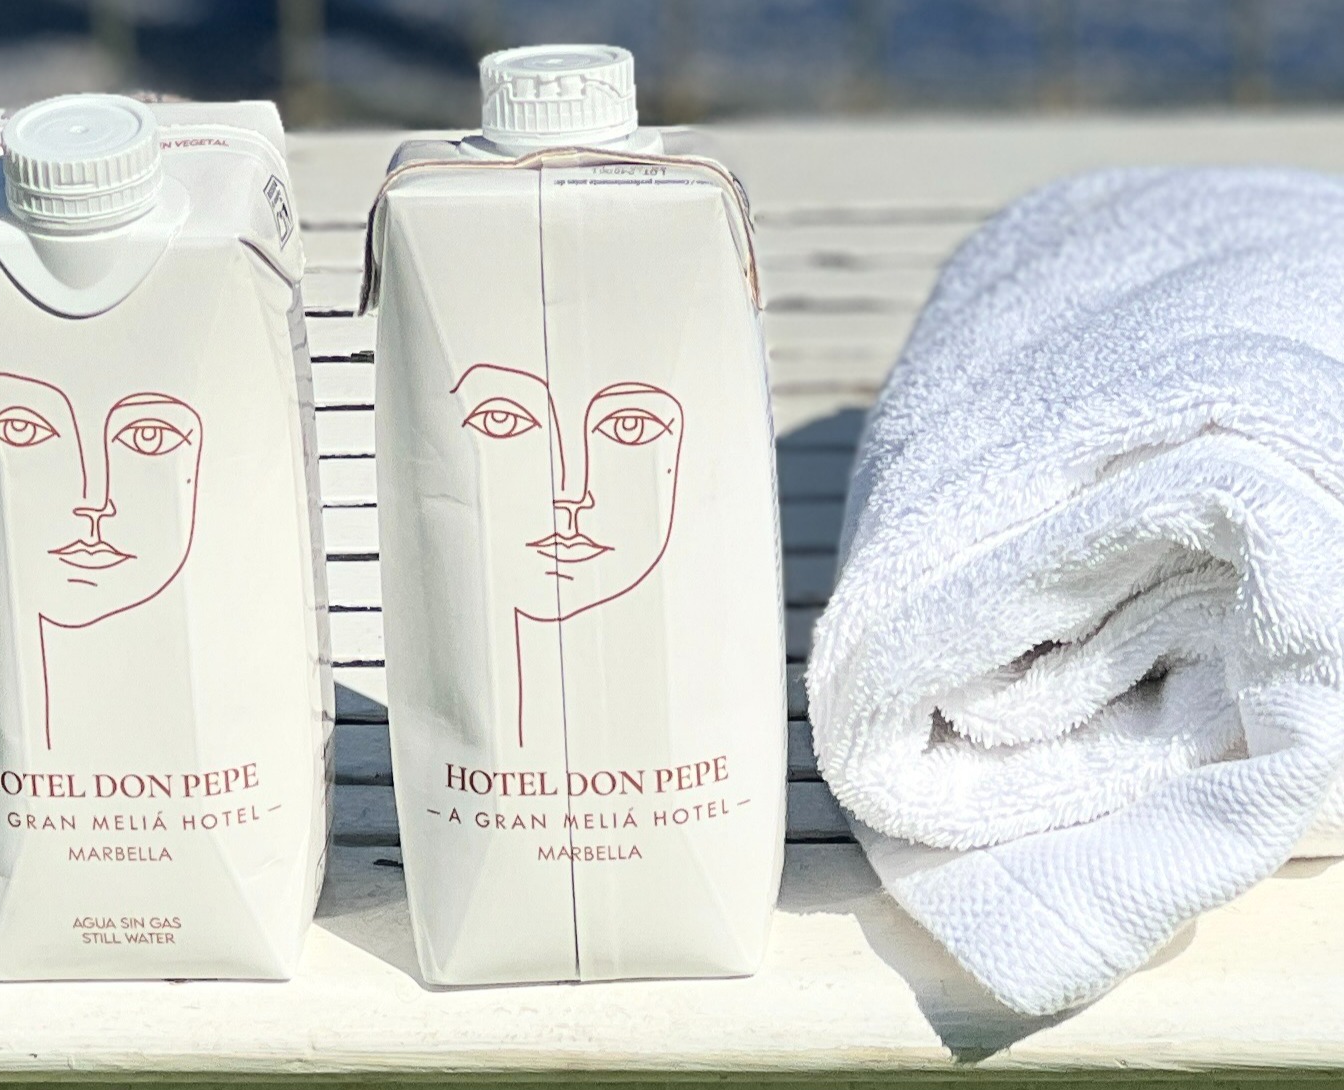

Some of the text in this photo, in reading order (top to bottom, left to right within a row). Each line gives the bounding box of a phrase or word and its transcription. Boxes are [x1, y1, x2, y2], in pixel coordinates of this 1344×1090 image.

[174, 138, 230, 148] VEGETAL
[91, 773, 174, 799] DON
[180, 761, 260, 798] PEPE
[444, 754, 729, 798] HOTEL DON PEPE
[7, 811, 77, 831] GRAN
[92, 810, 168, 832] MELIÁ
[182, 804, 261, 832] HOTEL
[448, 798, 730, 831] A GRAN MELIÁ HOTEL
[68, 846, 173, 862] MARBELLA
[537, 844, 643, 862] MARBELLA
[72, 916, 182, 930] AGUA SIN GAS
[81, 932, 176, 945] STILL WATER
